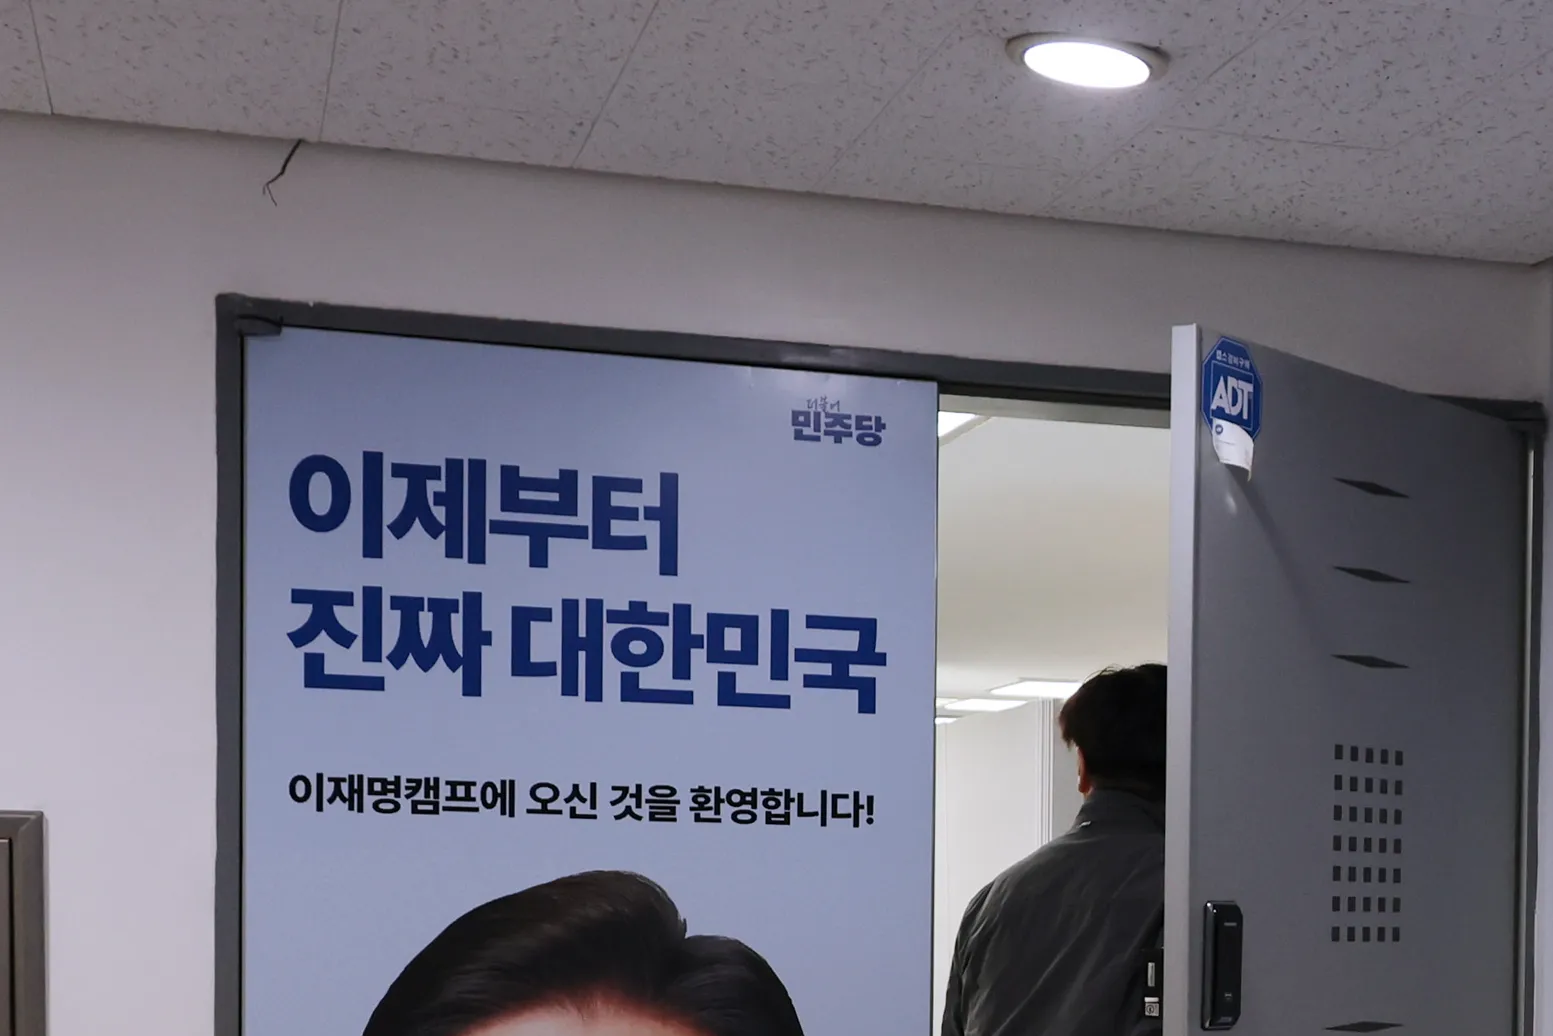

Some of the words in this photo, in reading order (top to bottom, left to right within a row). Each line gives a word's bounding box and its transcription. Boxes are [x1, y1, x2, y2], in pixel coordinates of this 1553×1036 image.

[1210, 375, 1254, 420] ADT
[791, 409, 887, 448] 민주당
[288, 450, 679, 577] 이제부터
[286, 585, 493, 698] 진짜
[510, 597, 888, 715] 대한민국
[288, 772, 516, 818] 이재명캠프에
[525, 781, 598, 820] 오신
[609, 783, 681, 823] 것을
[688, 785, 875, 829] 환영합니다!
